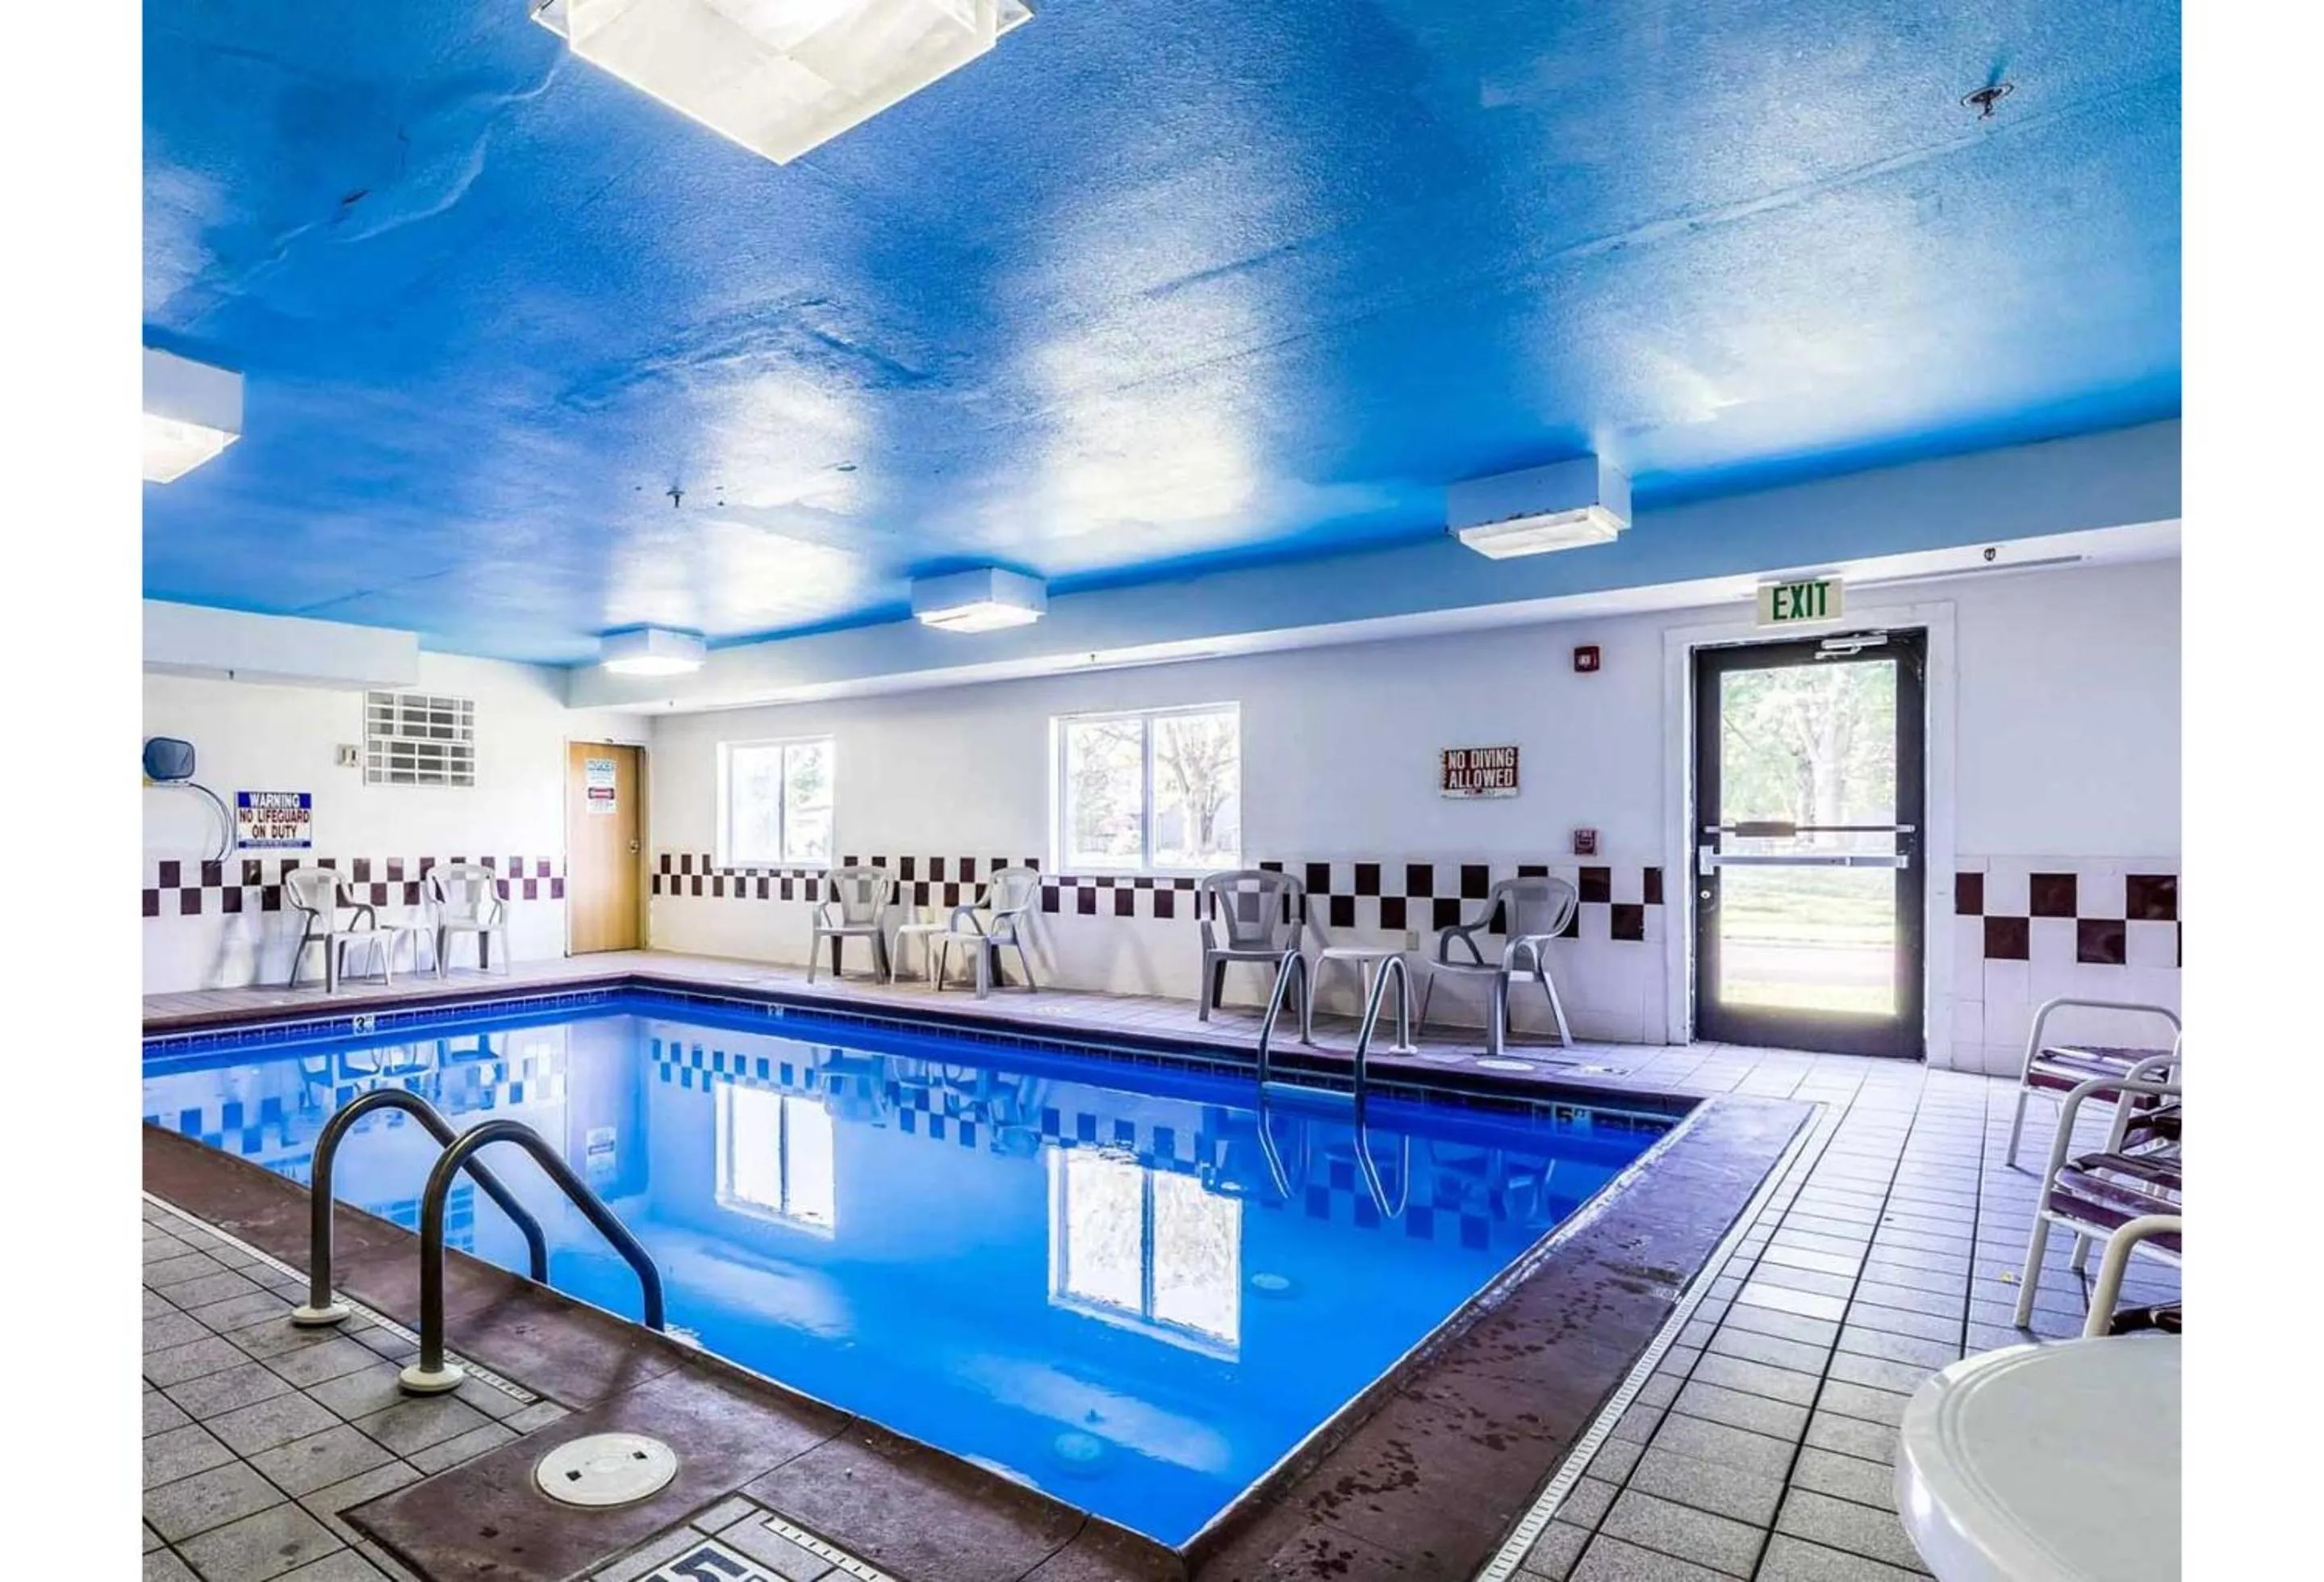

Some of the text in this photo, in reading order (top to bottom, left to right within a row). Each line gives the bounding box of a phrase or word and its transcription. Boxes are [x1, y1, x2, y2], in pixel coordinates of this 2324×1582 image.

[1773, 582, 1830, 621] EXIT
[1448, 748, 1515, 769] NO DIVING
[1449, 768, 1514, 789] ALLOWED
[249, 793, 300, 808] WARNING
[239, 810, 310, 823] NO LIFEGUARD
[252, 825, 297, 839] ON DUTY
